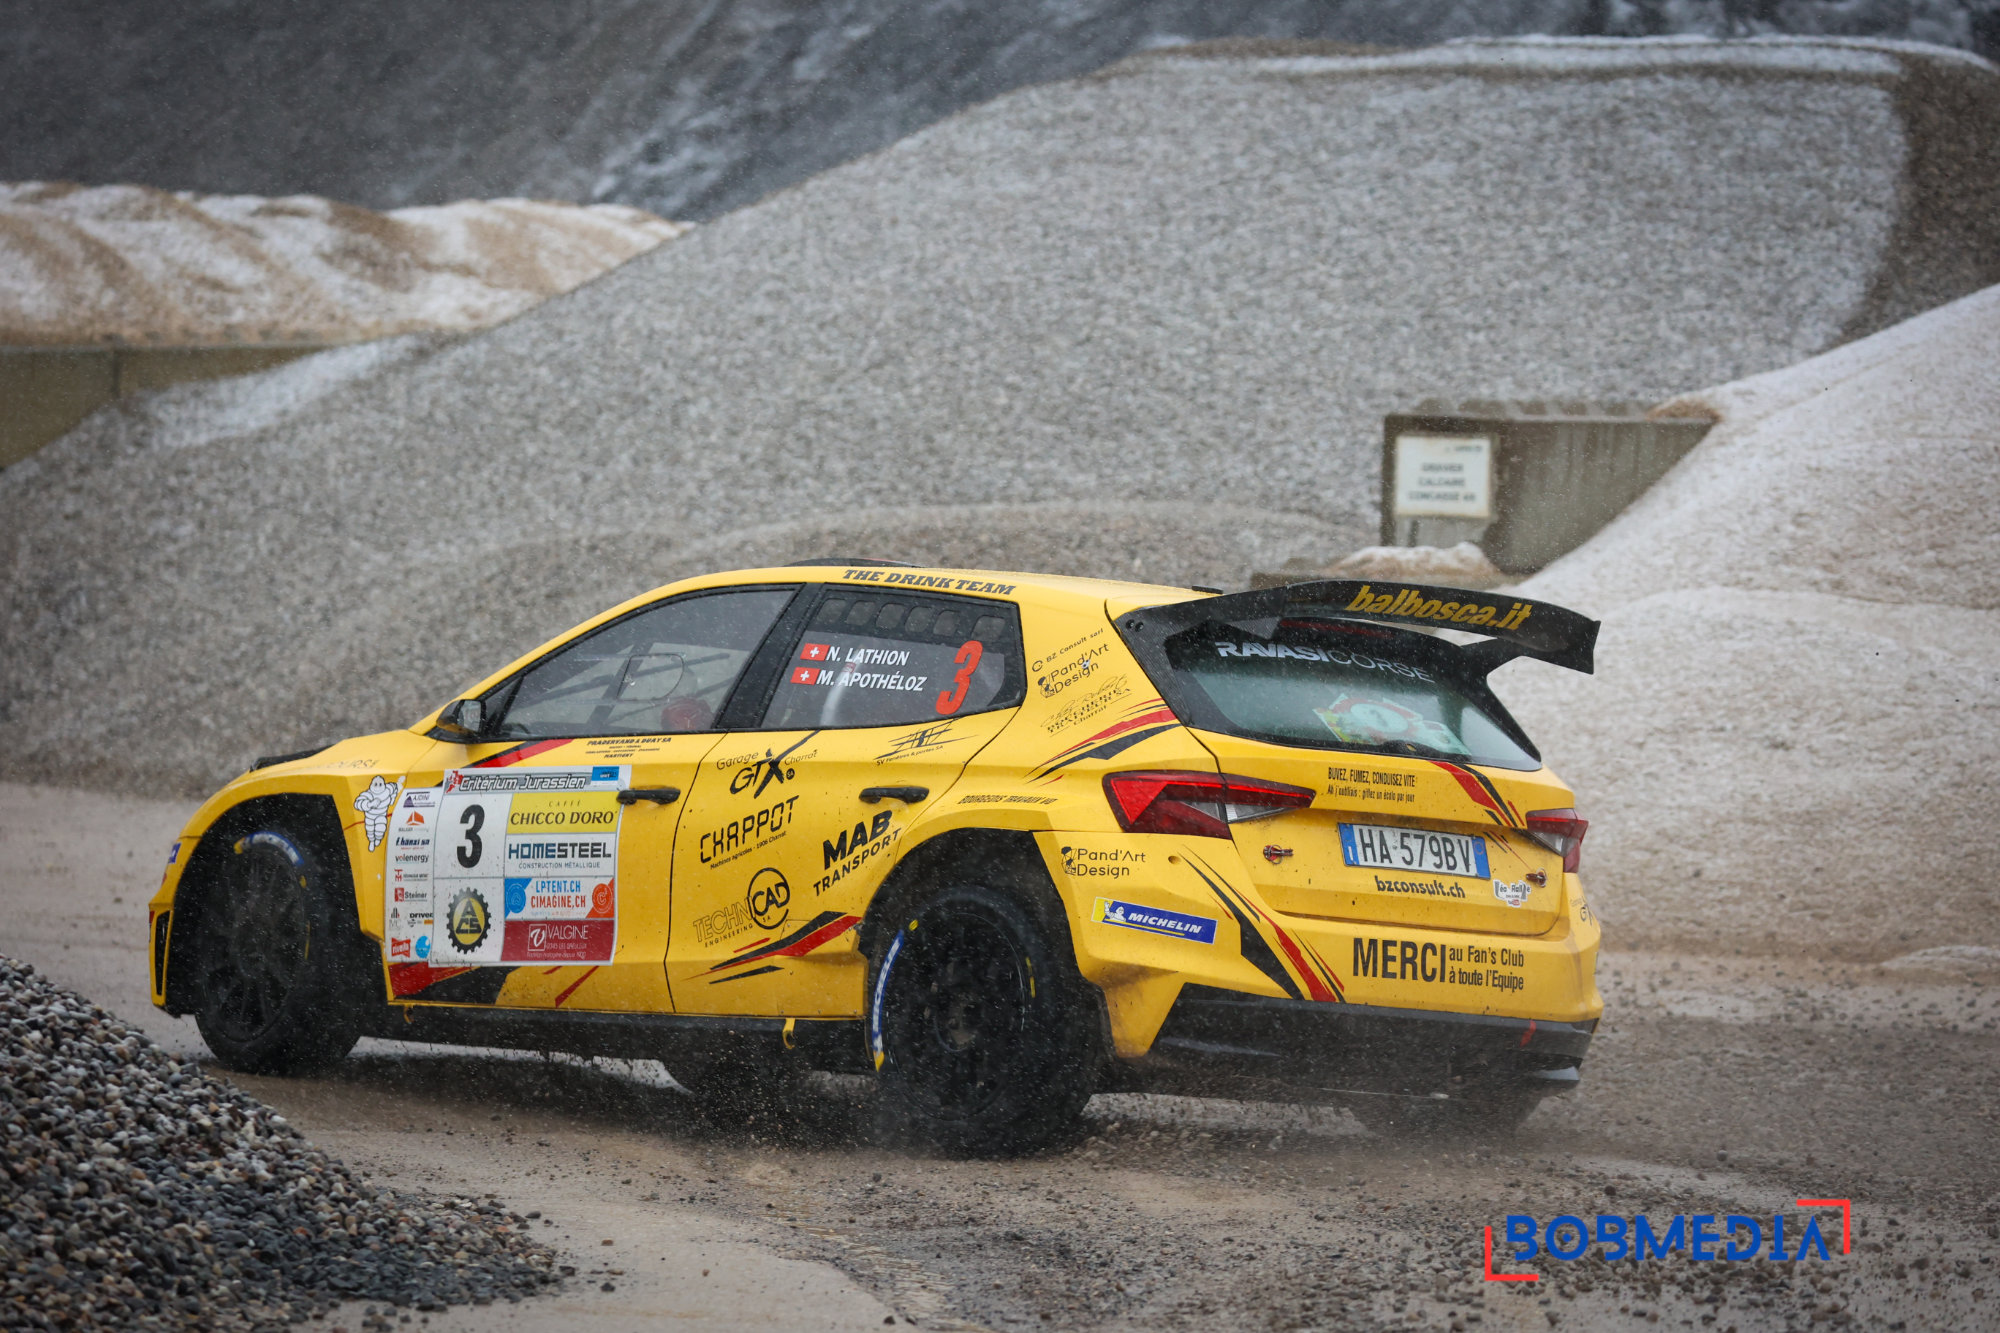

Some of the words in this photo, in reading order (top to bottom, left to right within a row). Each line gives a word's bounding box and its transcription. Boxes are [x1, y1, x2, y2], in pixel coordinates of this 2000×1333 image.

[842, 569, 888, 581] THE
[884, 572, 955, 589] DRINK
[955, 579, 1017, 596] TEAM
[1345, 584, 1533, 630] balbosca.it
[826, 646, 842, 662] N.
[845, 647, 910, 666] LATHION
[816, 670, 835, 686] M.
[838, 671, 928, 692] APOTHÉLOZ
[936, 640, 984, 716] 3
[1054, 662, 1099, 694] Design
[716, 751, 760, 770] Garage
[784, 750, 819, 767] Charrat
[459, 775, 518, 791] Critérium
[519, 774, 587, 790] Jurassien
[1372, 771, 1403, 787] CONDUISEZ
[510, 811, 566, 825] CHICCO
[570, 811, 614, 824] D'ORO
[456, 804, 485, 868] 3
[700, 795, 800, 864] CHAPPOT
[822, 809, 893, 870] MAB
[508, 843, 612, 859] HOMESTEEL
[813, 827, 902, 896] TRANSPORT
[1077, 848, 1147, 862] Pand'Art
[1359, 828, 1393, 864] HA
[1400, 832, 1470, 873] 579BV
[564, 859, 601, 869] MÉTALLIQUE
[1077, 864, 1131, 879] Design
[535, 880, 581, 893] LPTENT.CH
[1374, 875, 1466, 899] bzconsult.ch
[547, 924, 590, 940] VALGINE
[1128, 912, 1203, 934] MICHELIN
[705, 922, 754, 948] ENGINEERING
[1352, 937, 1447, 983] MERCI
[1449, 947, 1463, 962] au
[1468, 945, 1497, 965] Fan's
[1501, 948, 1524, 968] Club
[1449, 966, 1456, 984] à
[1458, 967, 1483, 987] toute
[1486, 969, 1524, 994] l'Equipe
